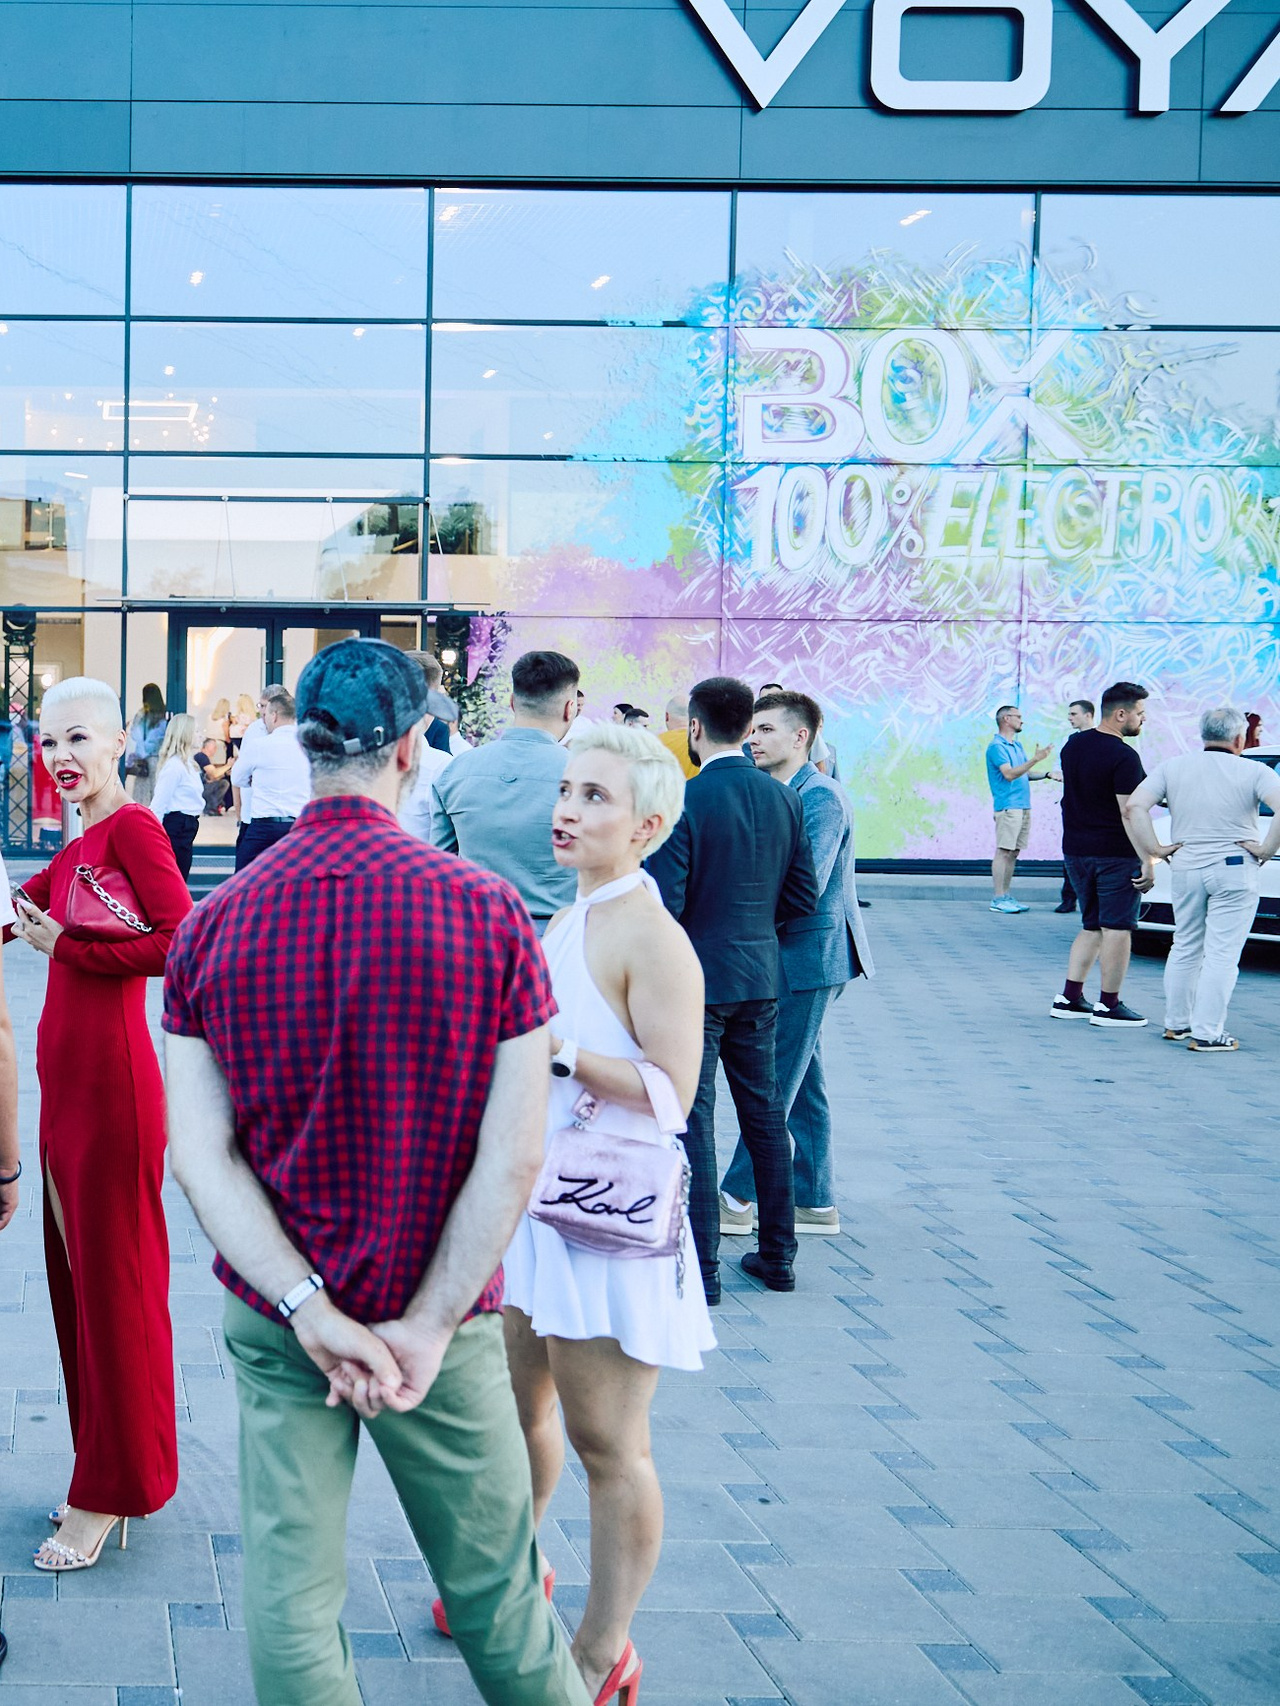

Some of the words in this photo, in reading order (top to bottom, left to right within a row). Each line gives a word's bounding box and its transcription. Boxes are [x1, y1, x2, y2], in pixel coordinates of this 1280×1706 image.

[736, 328, 1087, 461] BOX
[732, 465, 923, 571] 100%
[926, 464, 1231, 566] ELECTRO
[540, 1175, 657, 1224] Karl
